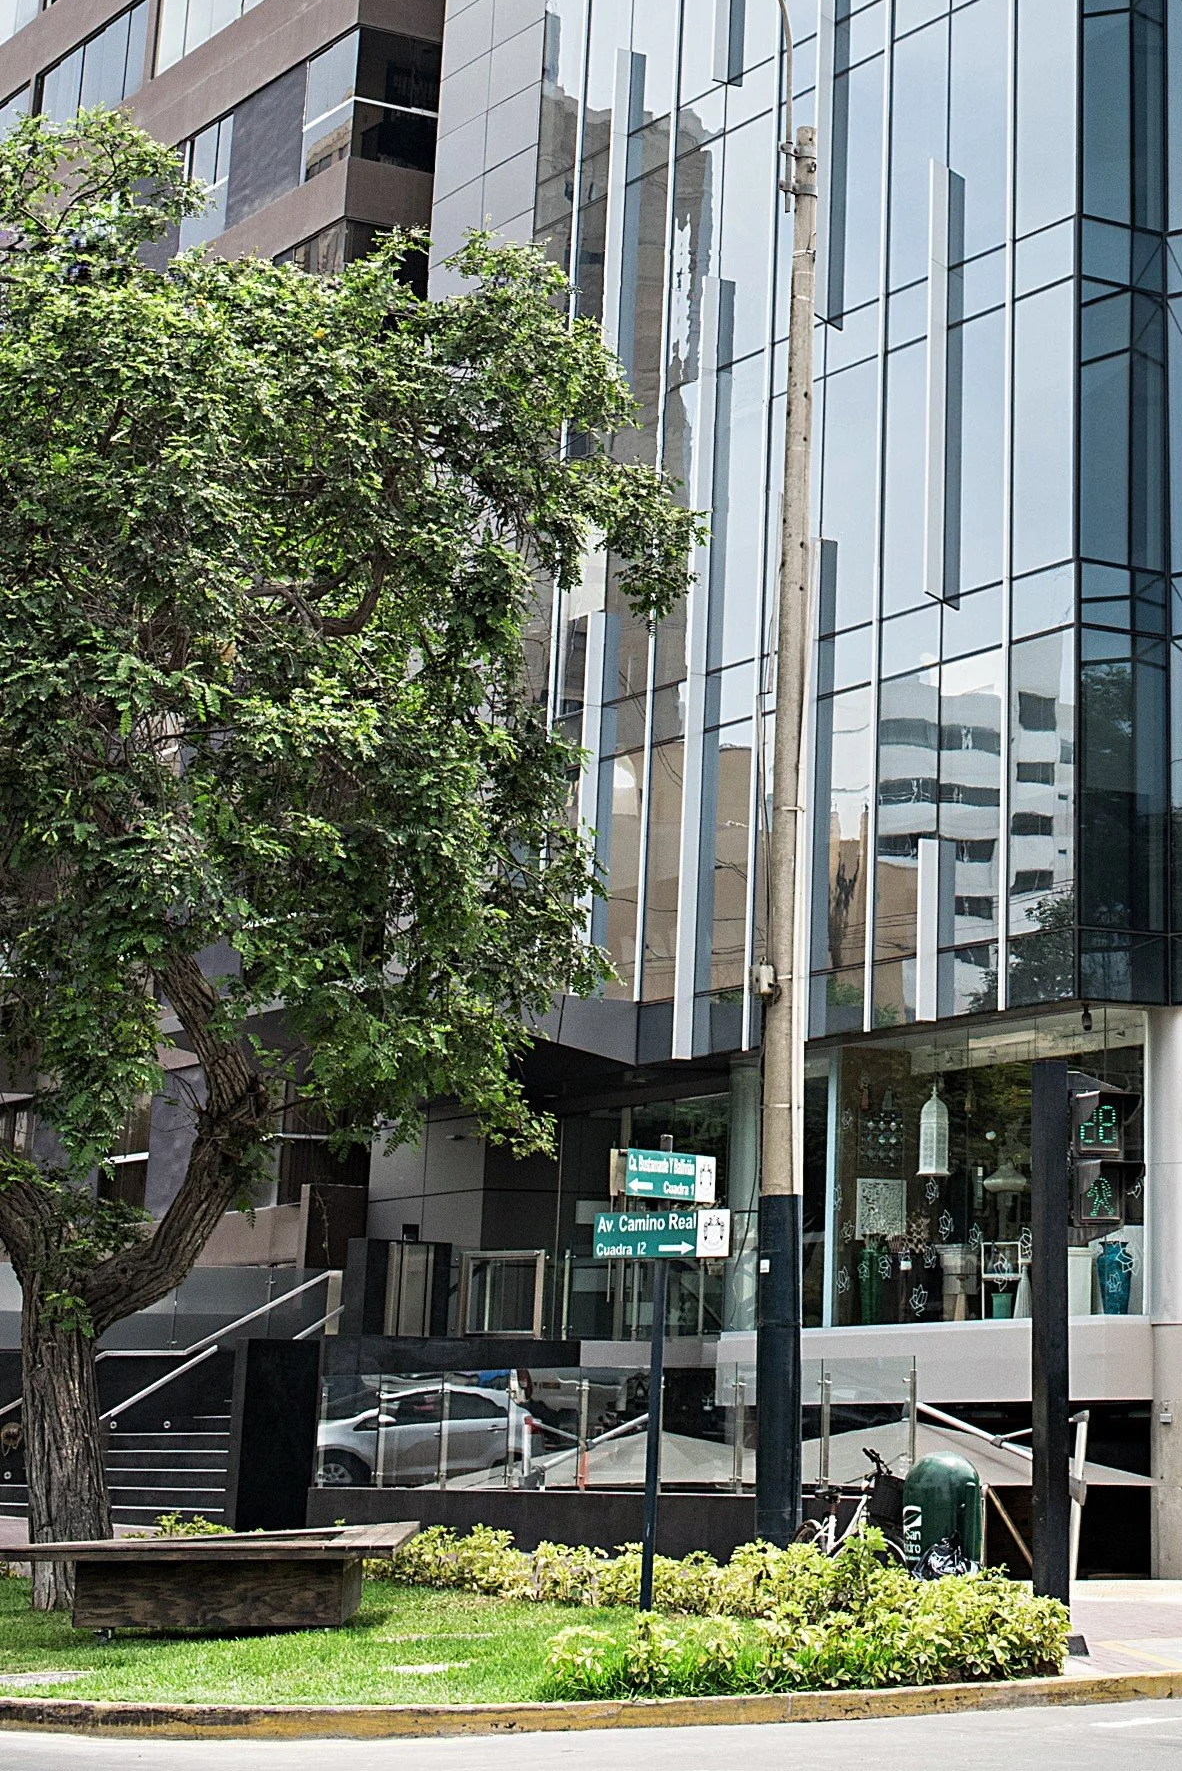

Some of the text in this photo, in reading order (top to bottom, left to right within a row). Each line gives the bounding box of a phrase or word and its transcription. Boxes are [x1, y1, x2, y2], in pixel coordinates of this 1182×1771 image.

[669, 1157, 674, 1174] Y
[664, 1181, 689, 1195] Cuadra
[597, 1213, 697, 1233] Av. Camino Real
[596, 1242, 647, 1256] Cuadra 12
[905, 1527, 921, 1540] San
